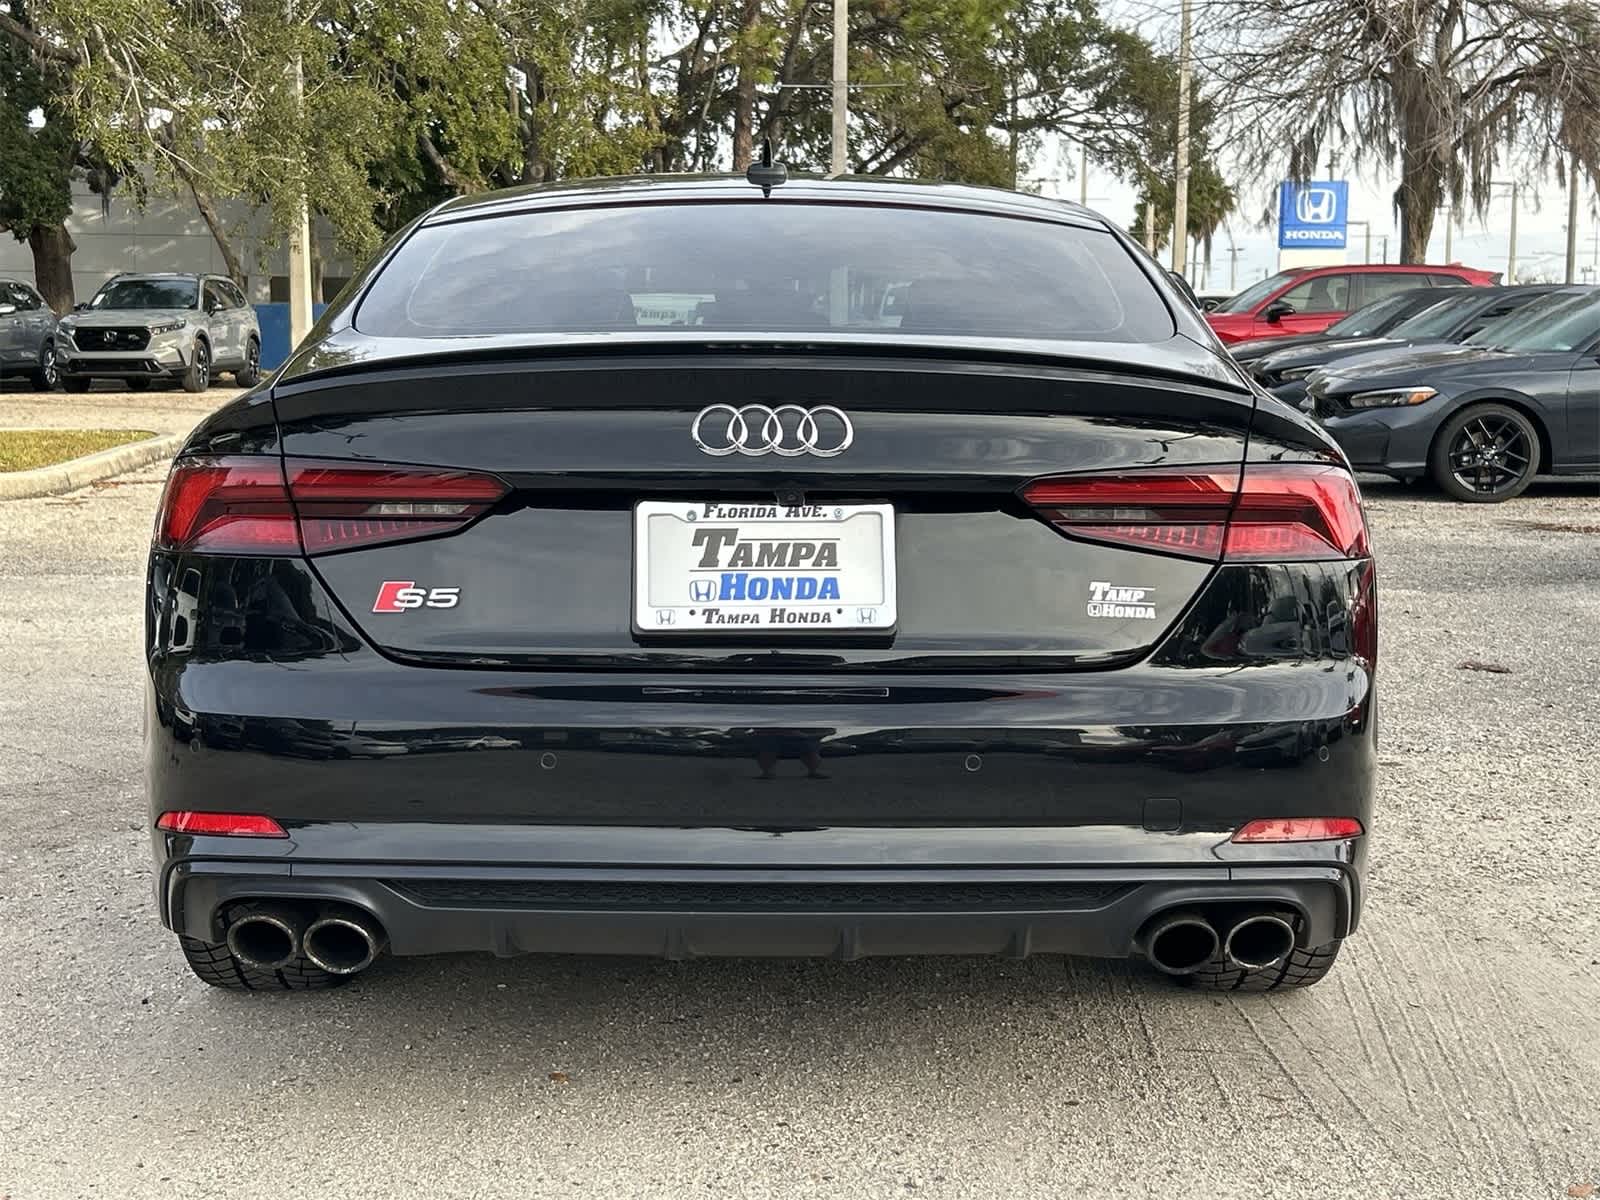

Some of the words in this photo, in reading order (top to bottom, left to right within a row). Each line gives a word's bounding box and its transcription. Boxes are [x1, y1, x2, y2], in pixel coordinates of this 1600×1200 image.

[1285, 231, 1343, 240] HONDA
[703, 503, 777, 518] FLORIDA
[691, 528, 838, 568] TAMPA
[718, 573, 841, 601] HONDA
[393, 588, 460, 608] S5
[702, 608, 760, 624] TAMPA
[769, 608, 832, 624] HONDA
[1102, 603, 1156, 619] HONDA
